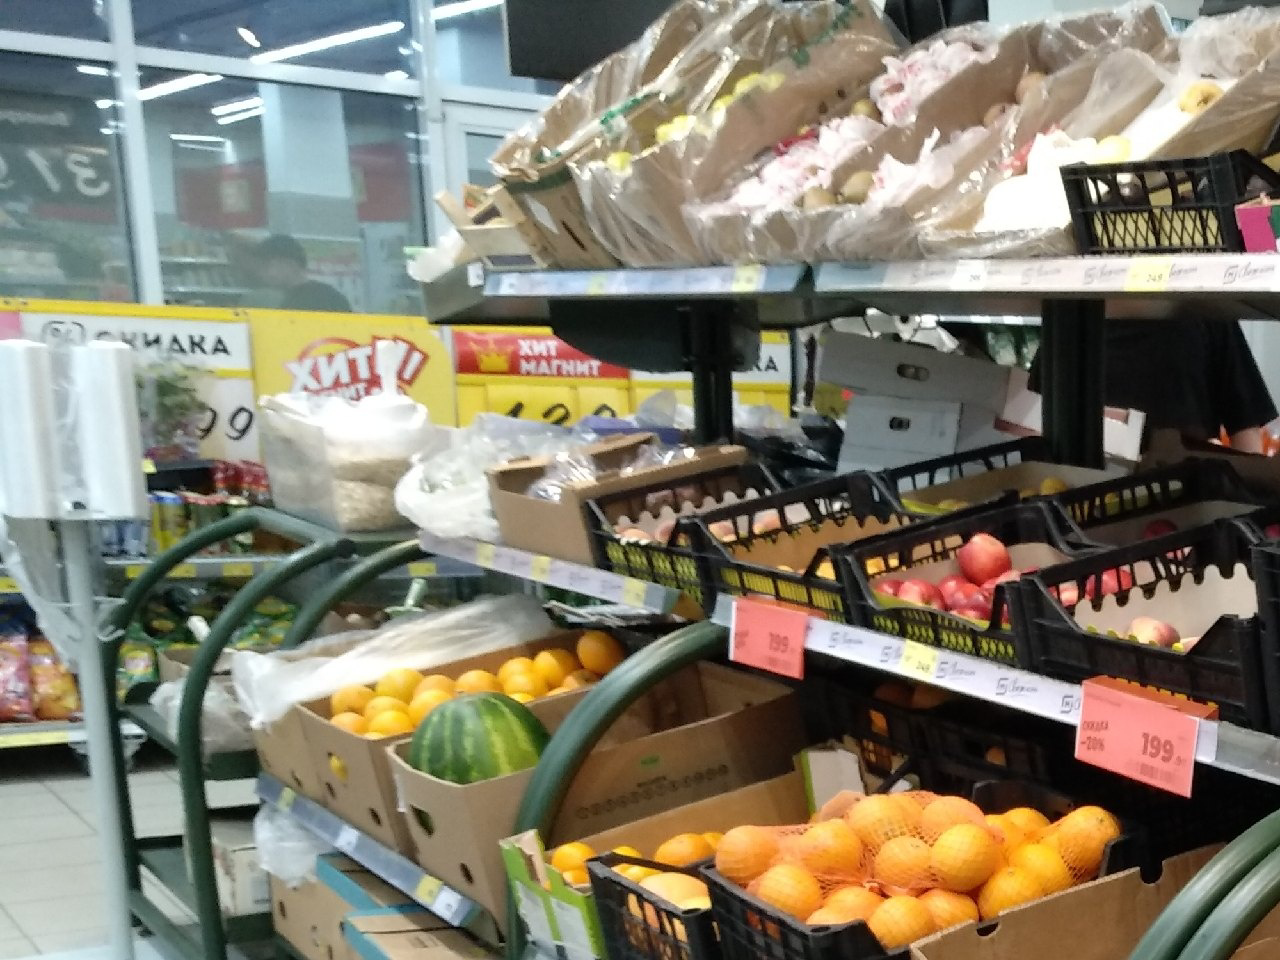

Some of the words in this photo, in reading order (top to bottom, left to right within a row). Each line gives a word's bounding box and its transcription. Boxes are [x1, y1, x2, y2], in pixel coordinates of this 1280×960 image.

[517, 339, 559, 356] ХИТ
[519, 359, 603, 376] МАГНИТ
[1142, 733, 1174, 763] 199
